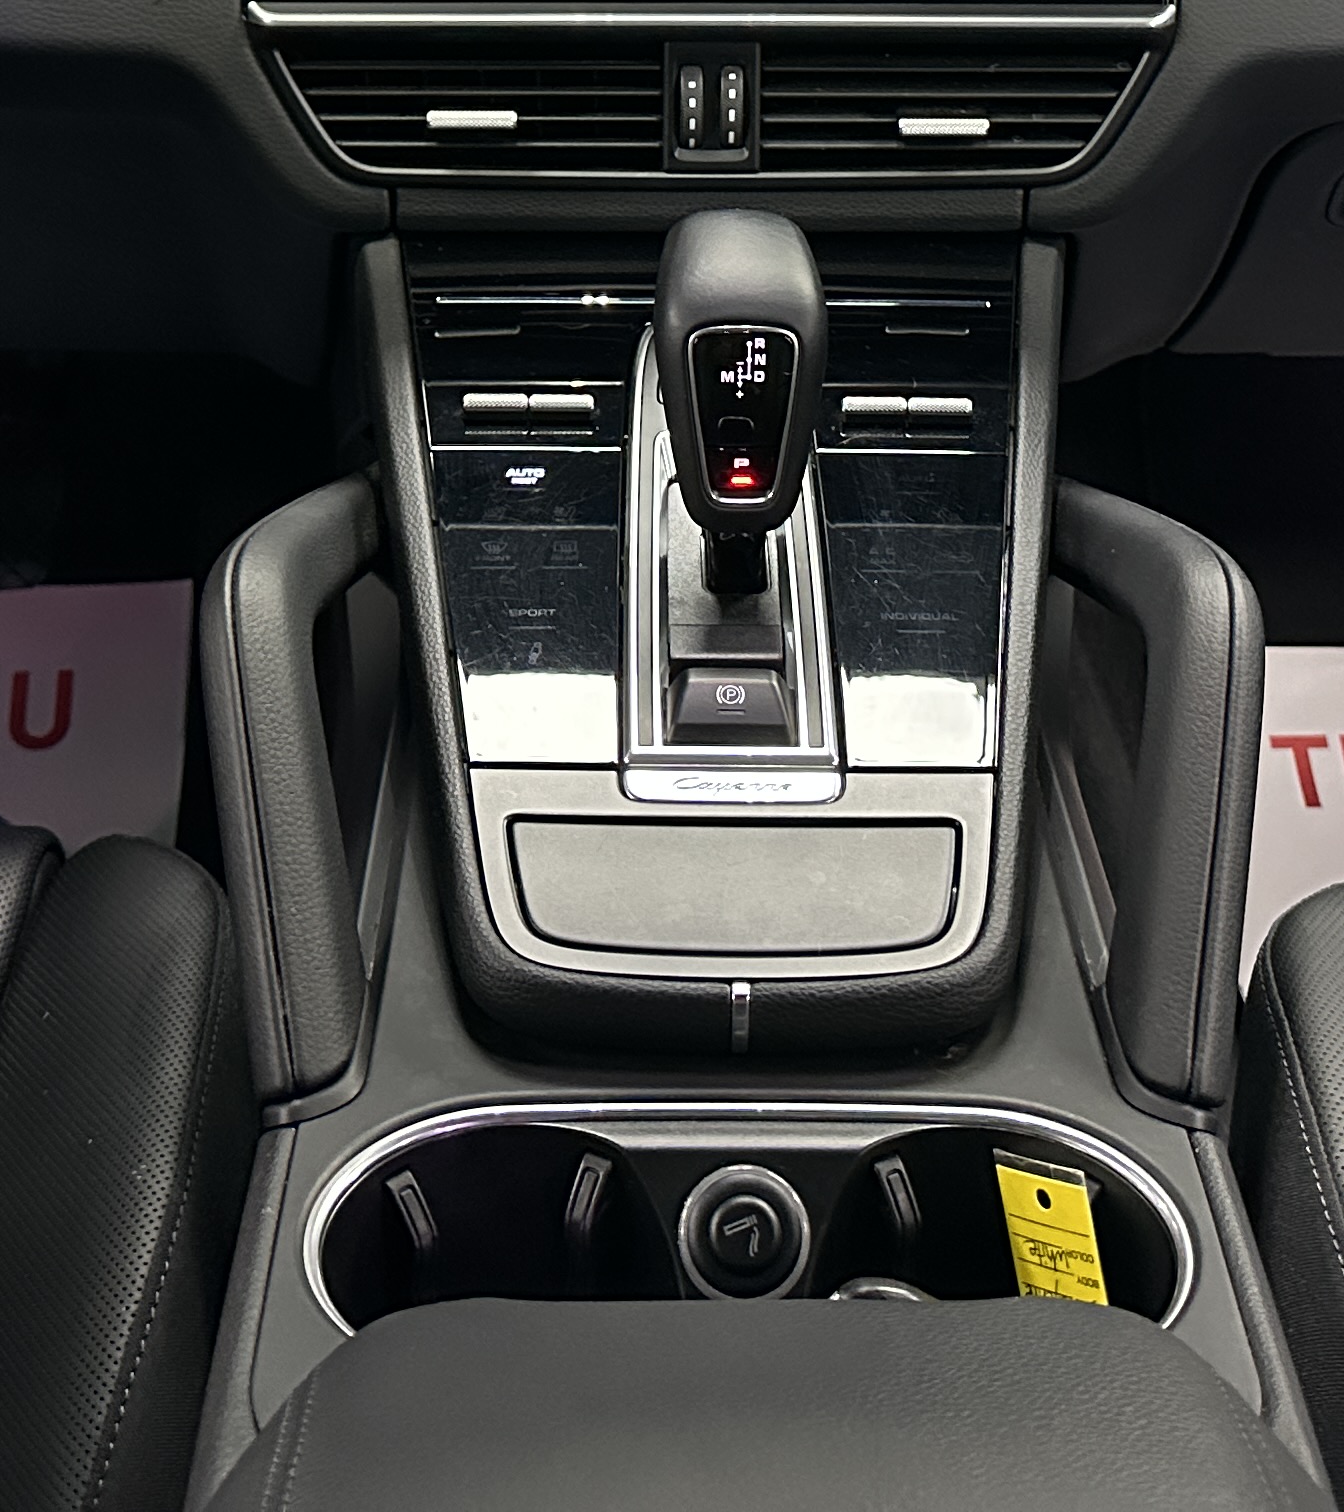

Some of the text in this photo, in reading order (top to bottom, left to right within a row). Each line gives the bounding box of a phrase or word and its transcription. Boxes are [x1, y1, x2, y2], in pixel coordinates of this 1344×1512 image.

[754, 337, 766, 350] R
[754, 353, 767, 366] N
[720, 370, 735, 383] M
[753, 370, 766, 383] D
[733, 457, 750, 469] P
[504, 467, 546, 478] AUTO
[508, 608, 557, 618] SPORT
[879, 612, 960, 622] INDIVIDUAL
